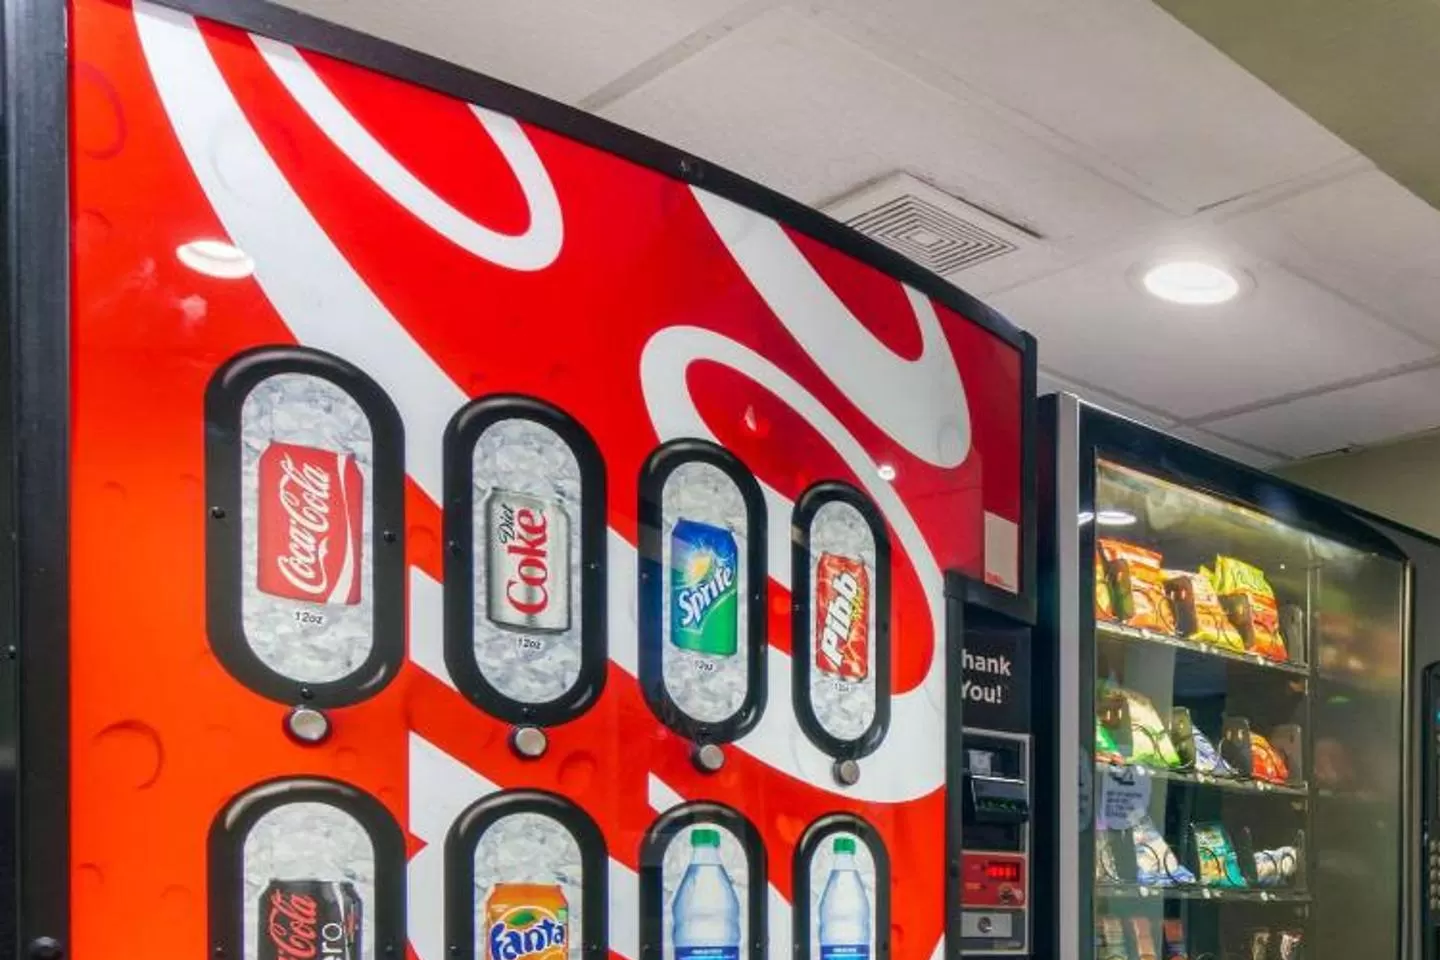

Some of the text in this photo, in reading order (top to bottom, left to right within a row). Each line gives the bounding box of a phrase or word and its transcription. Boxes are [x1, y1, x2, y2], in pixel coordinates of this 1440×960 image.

[276, 451, 332, 595] Coca-Cola
[499, 504, 515, 543] Diet
[506, 508, 549, 616] Coke
[678, 563, 734, 626] Sprite
[294, 611, 323, 626] 12oz
[517, 637, 542, 650] 12oz
[961, 648, 1012, 676] hank
